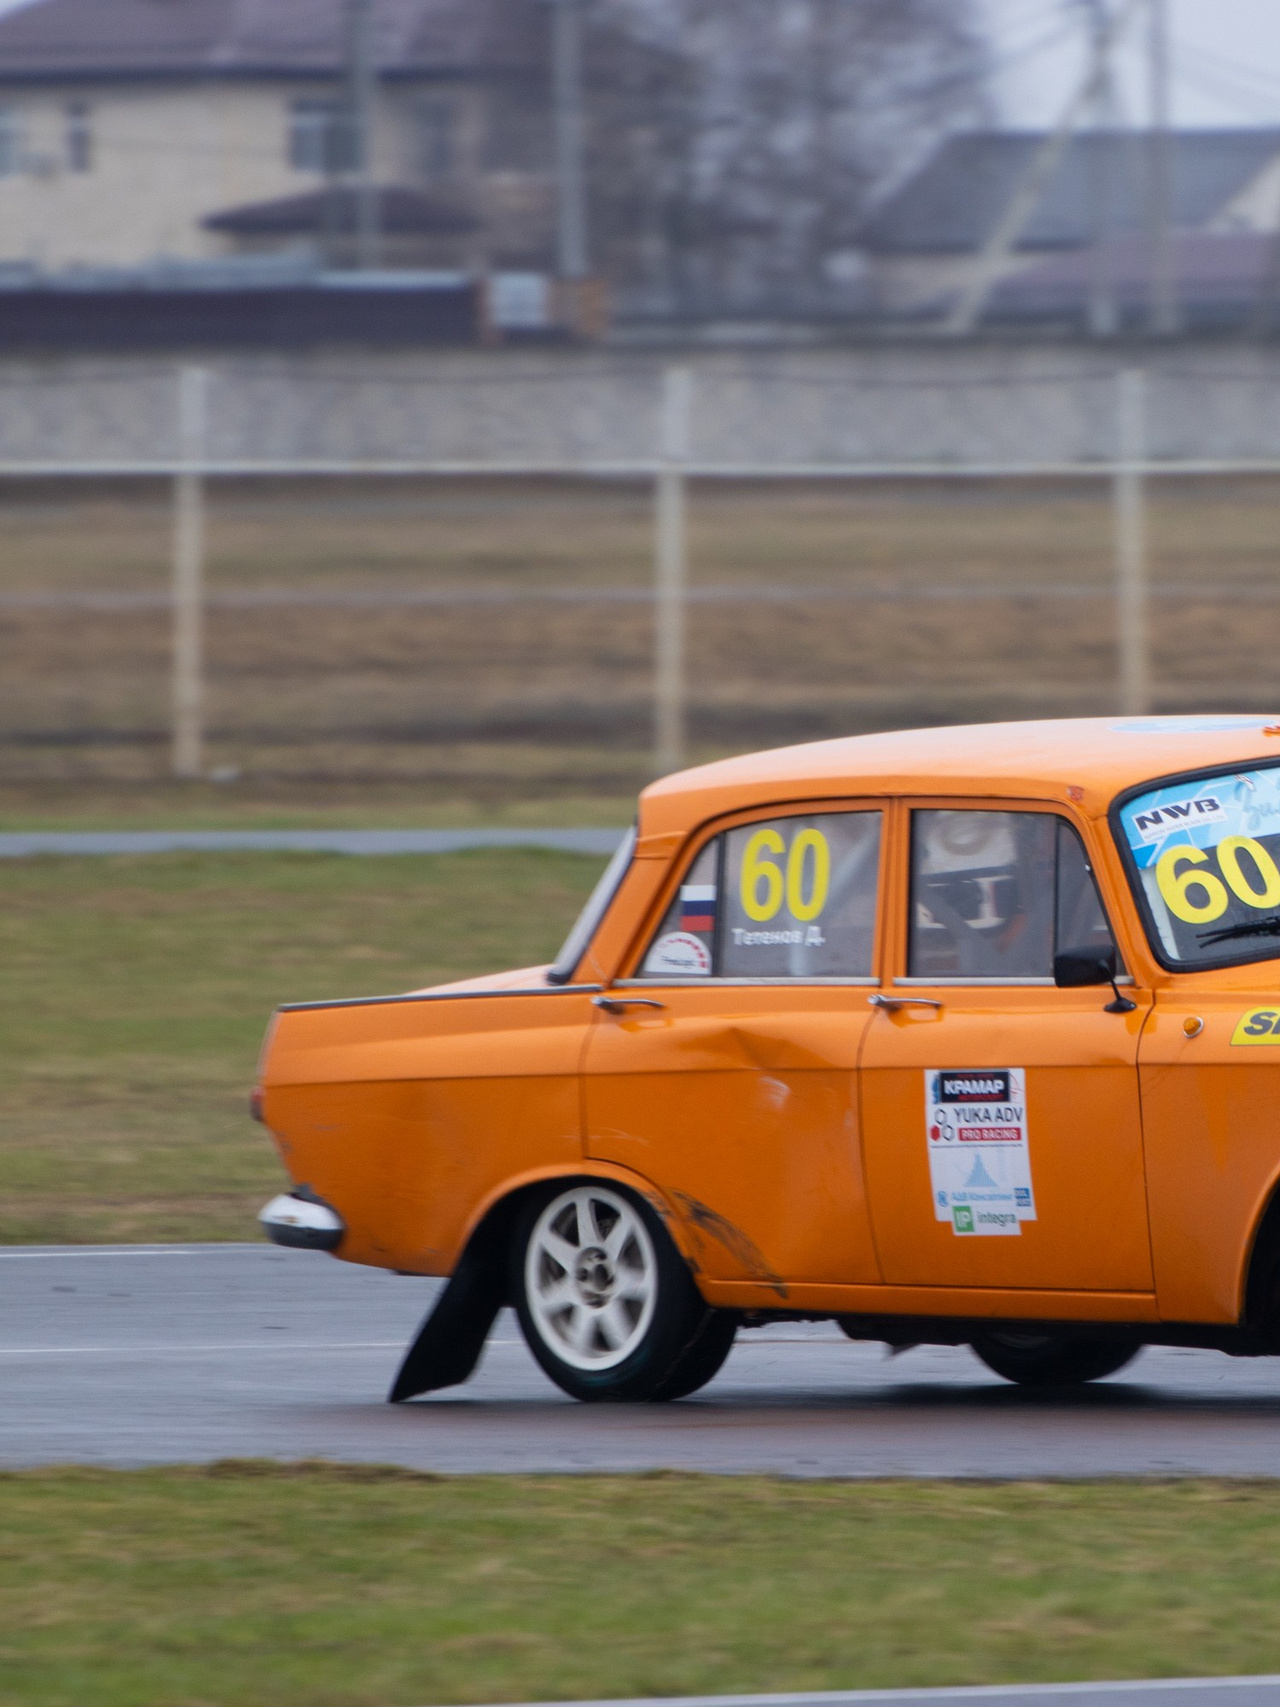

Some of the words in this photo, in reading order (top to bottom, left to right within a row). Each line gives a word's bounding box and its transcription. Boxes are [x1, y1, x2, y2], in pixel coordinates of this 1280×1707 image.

[1135, 798, 1220, 830] NWB
[740, 828, 831, 922] 60
[953, 1107, 992, 1123] YUKA
[995, 1107, 1023, 1122] ADV
[961, 1129, 981, 1140] PRO
[982, 1128, 1018, 1140] RACING
[976, 1211, 1017, 1227] integra
